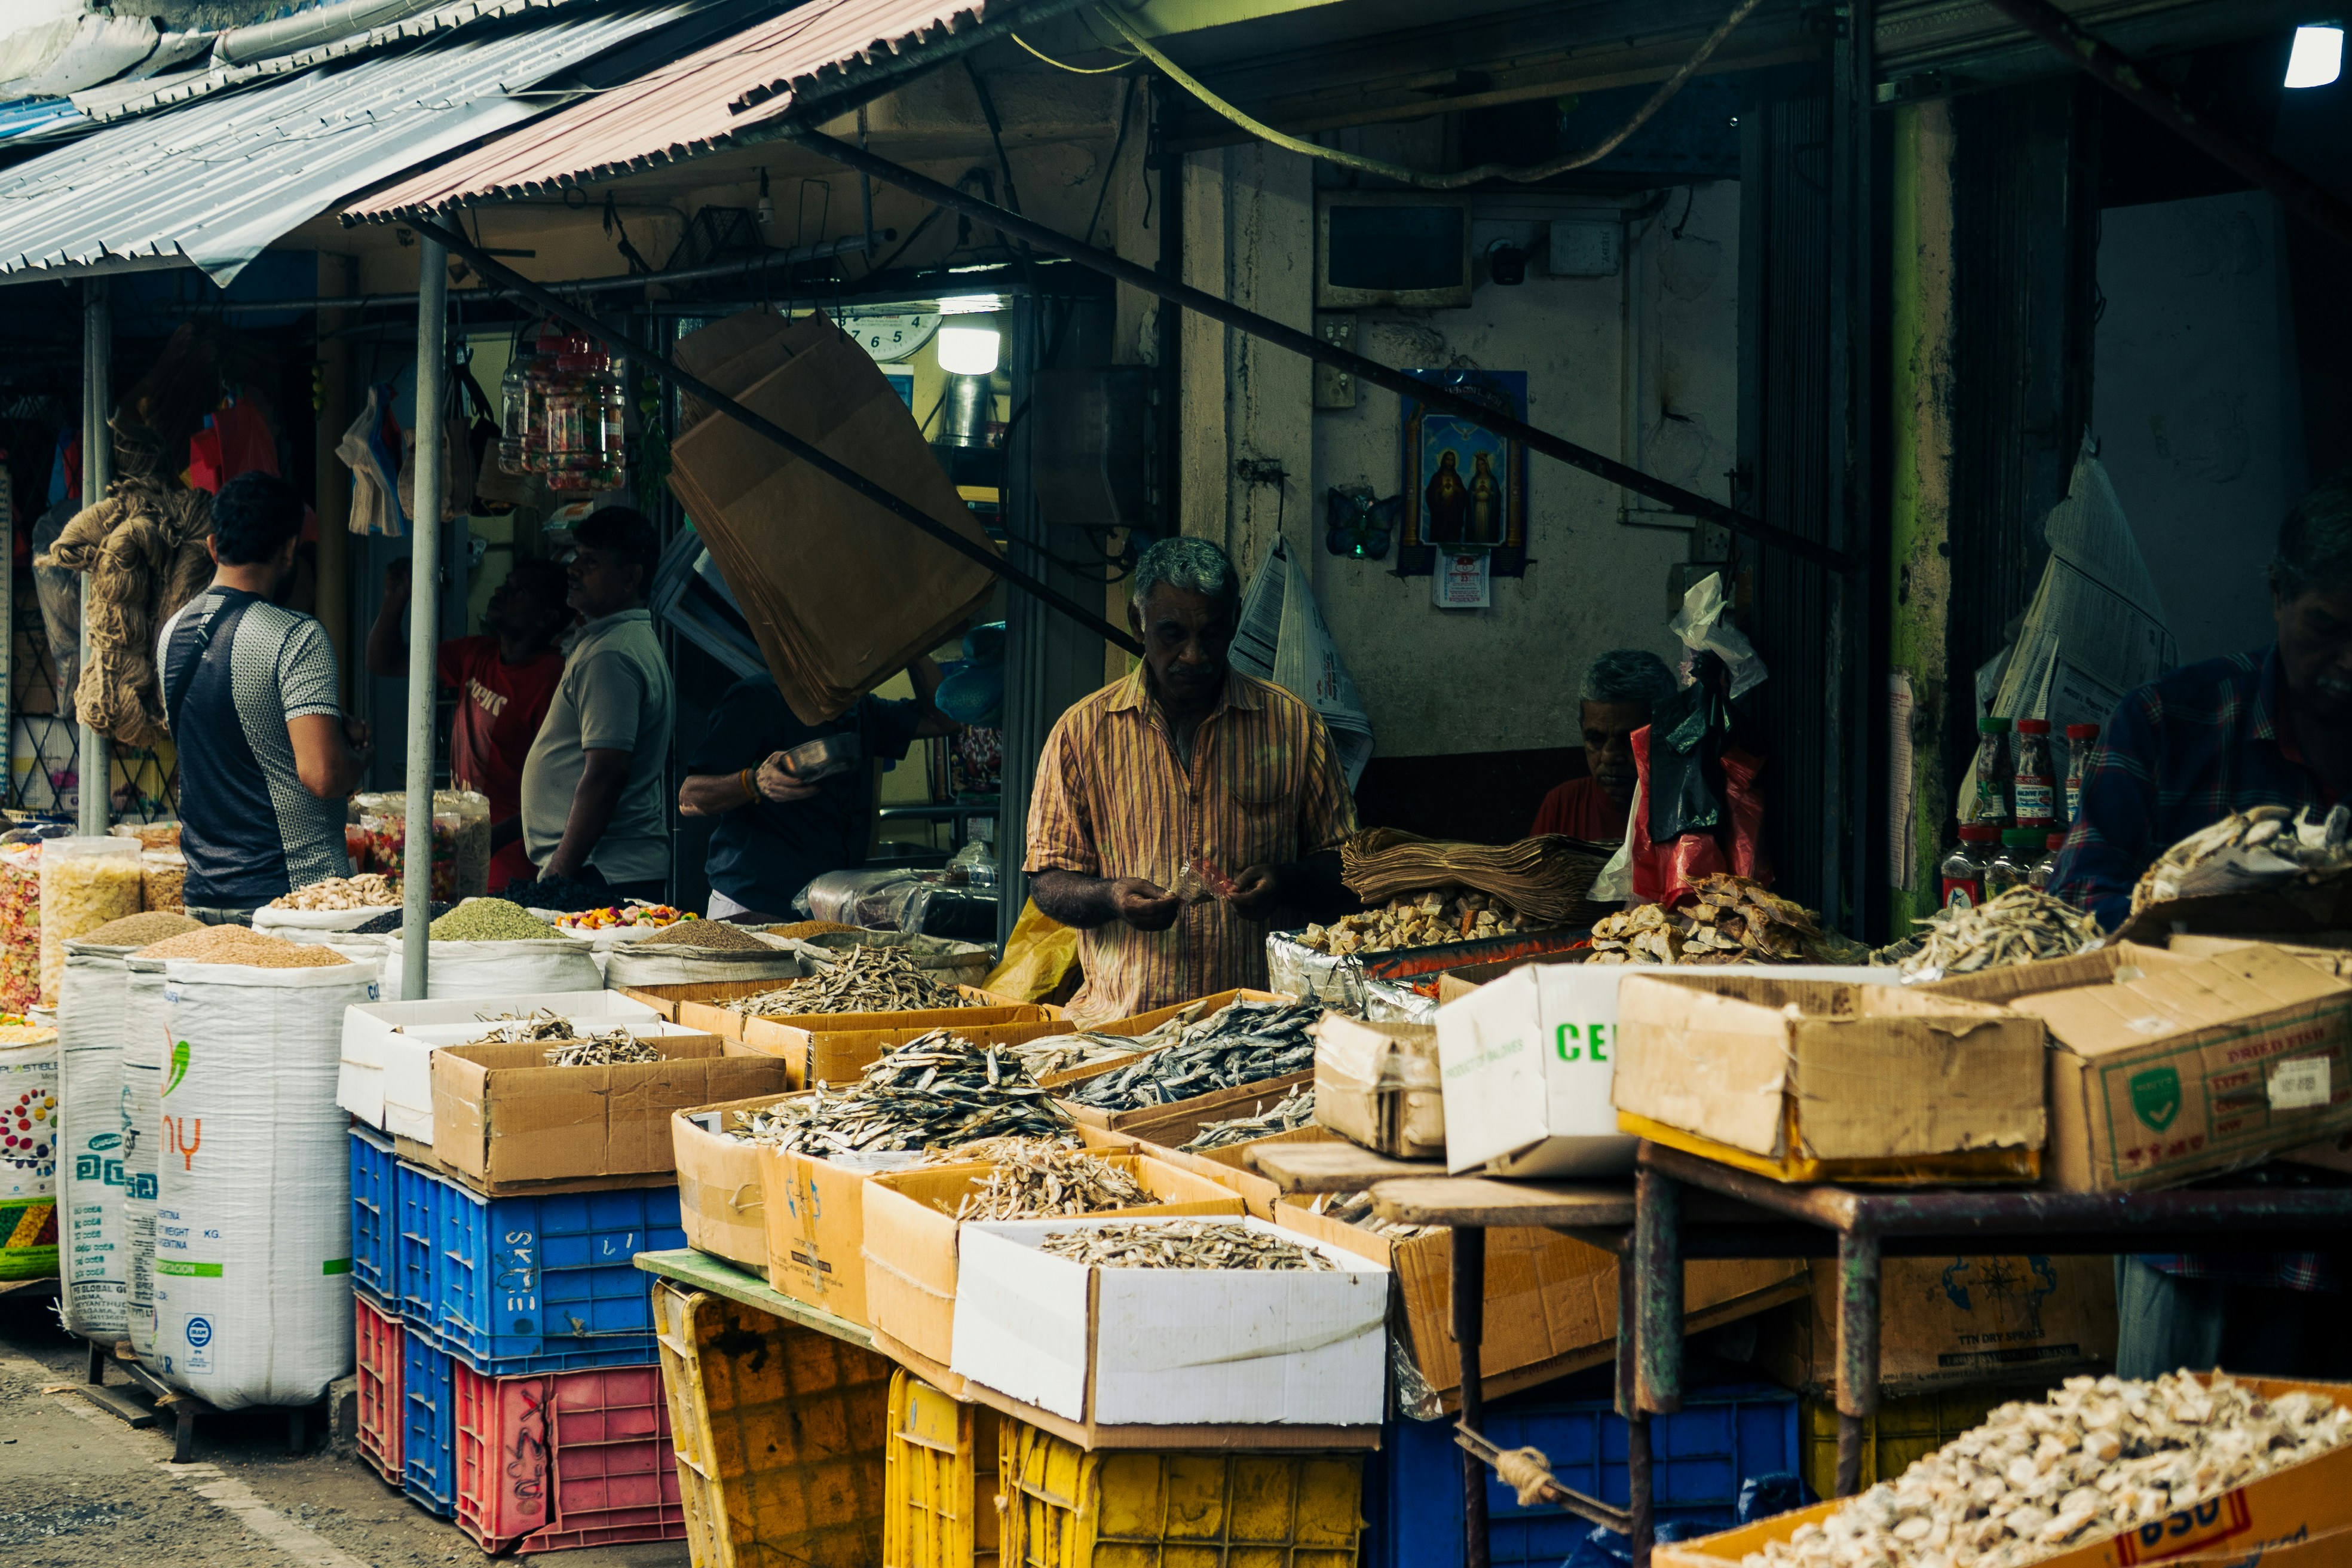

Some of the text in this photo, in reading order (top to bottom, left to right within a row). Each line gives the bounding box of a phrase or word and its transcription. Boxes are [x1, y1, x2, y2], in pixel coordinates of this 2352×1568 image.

[911, 316, 920, 328] 4
[871, 336, 880, 348] 6
[893, 330, 902, 343] 5
[1556, 1023, 1617, 1062] CE
[2228, 1039, 2283, 1063] DRIED
[2287, 1027, 2324, 1048] FISH
[204, 1229, 222, 1239] KG.
[1958, 1335, 1980, 1346] TTN
[1982, 1331, 2002, 1344] DRY
